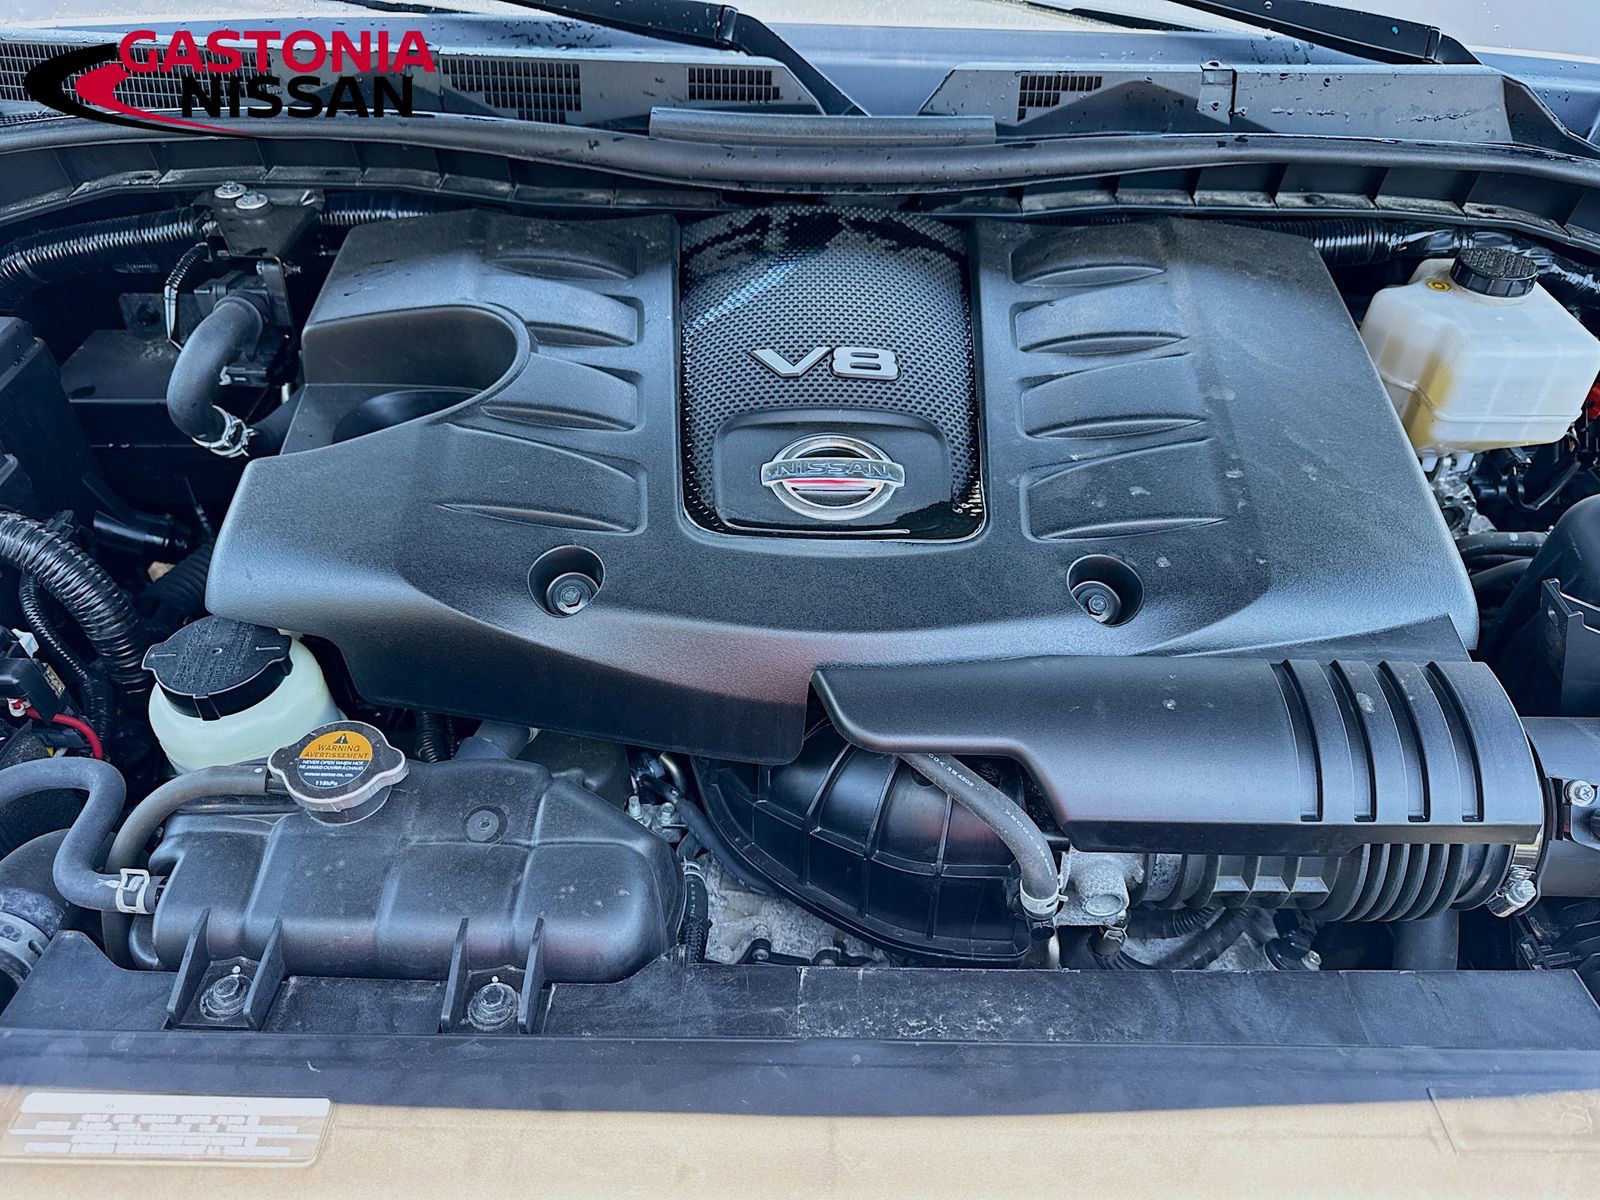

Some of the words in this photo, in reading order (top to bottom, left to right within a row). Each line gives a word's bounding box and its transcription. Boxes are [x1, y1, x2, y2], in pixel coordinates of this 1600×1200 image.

[748, 346, 900, 380] V8
[776, 462, 890, 476] NISSAN
[318, 744, 360, 752] WARNING
[304, 751, 369, 759] AVERTISSEMENT
